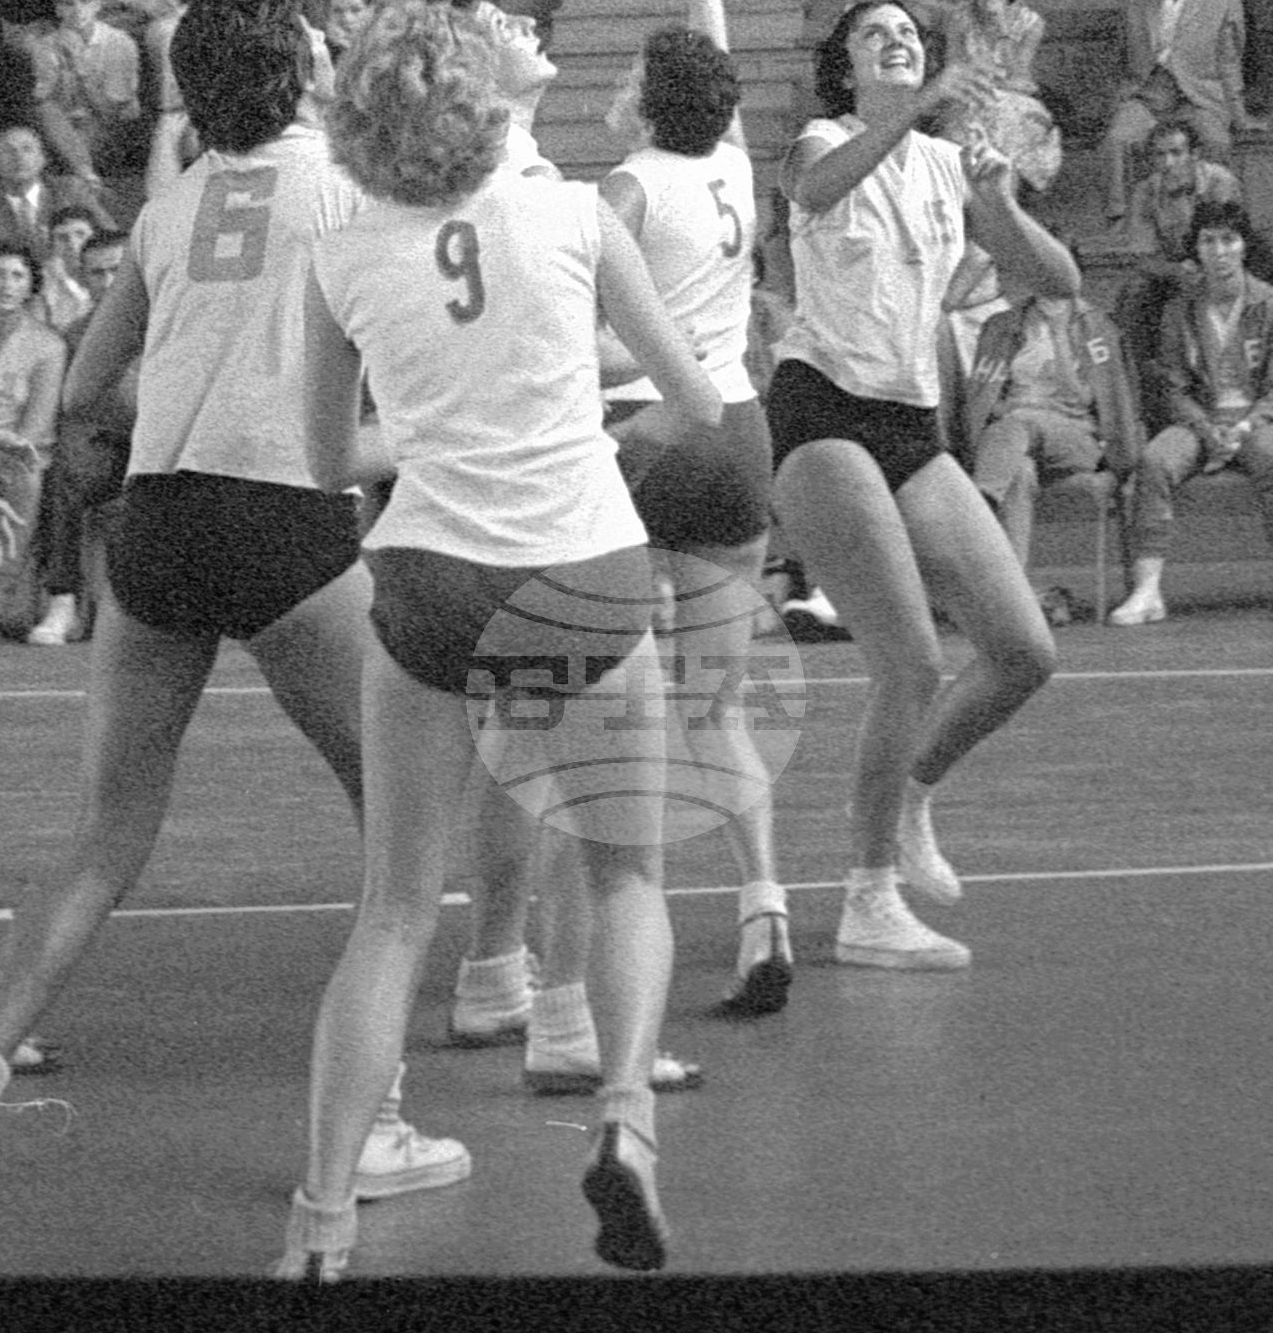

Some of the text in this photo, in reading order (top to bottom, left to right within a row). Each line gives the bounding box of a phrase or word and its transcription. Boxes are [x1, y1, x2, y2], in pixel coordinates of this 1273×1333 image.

[186, 165, 278, 284] 6
[706, 176, 743, 260] 5
[434, 219, 486, 326] 9
